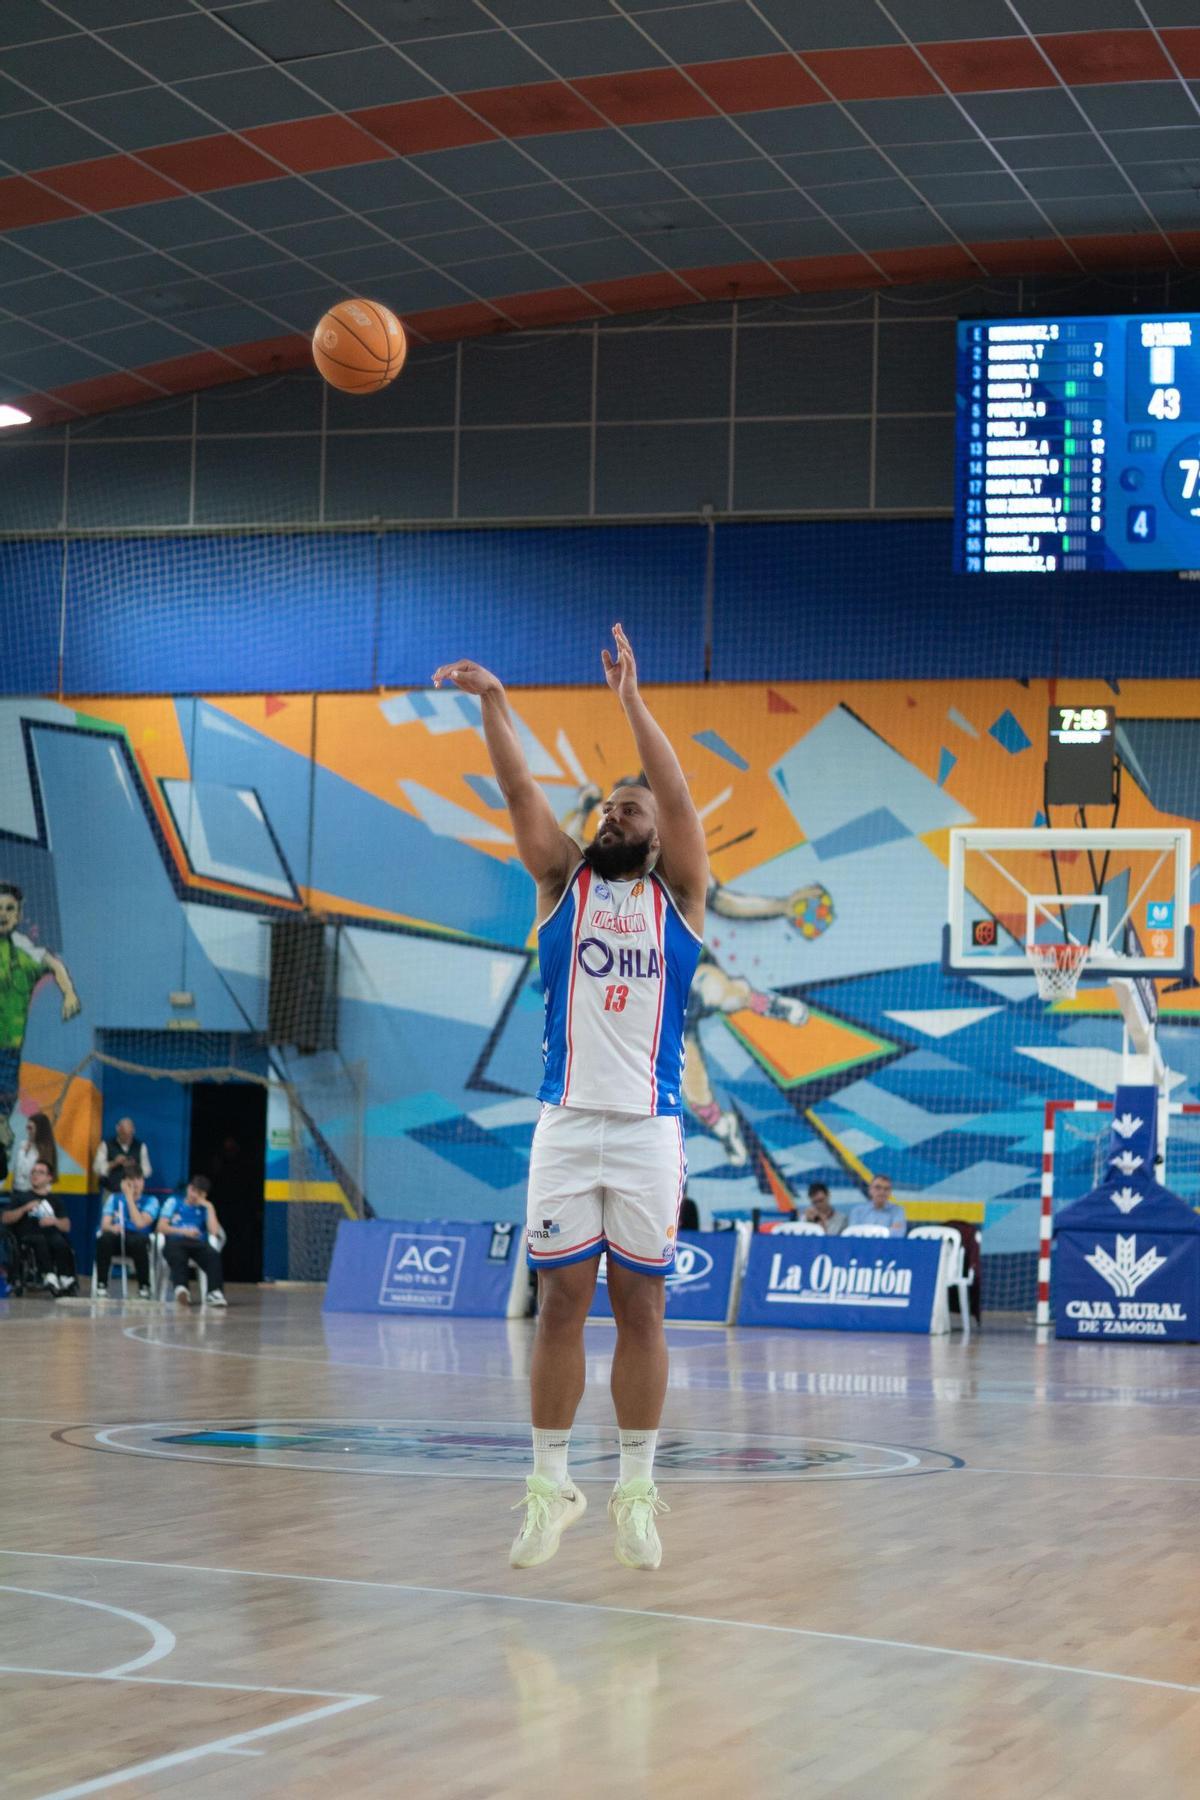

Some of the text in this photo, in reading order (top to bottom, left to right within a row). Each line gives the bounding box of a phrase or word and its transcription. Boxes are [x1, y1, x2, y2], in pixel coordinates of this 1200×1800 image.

[1094, 342, 1103, 357] 7
[1148, 388, 1180, 420] 43
[1133, 510, 1148, 538] 4
[603, 984, 630, 1013] 13
[396, 1245, 452, 1273] AC
[768, 1252, 912, 1302] La Opinión
[1065, 1299, 1187, 1321] CAJA RURAL
[1077, 1319, 1167, 1336] DE ZAMORA
